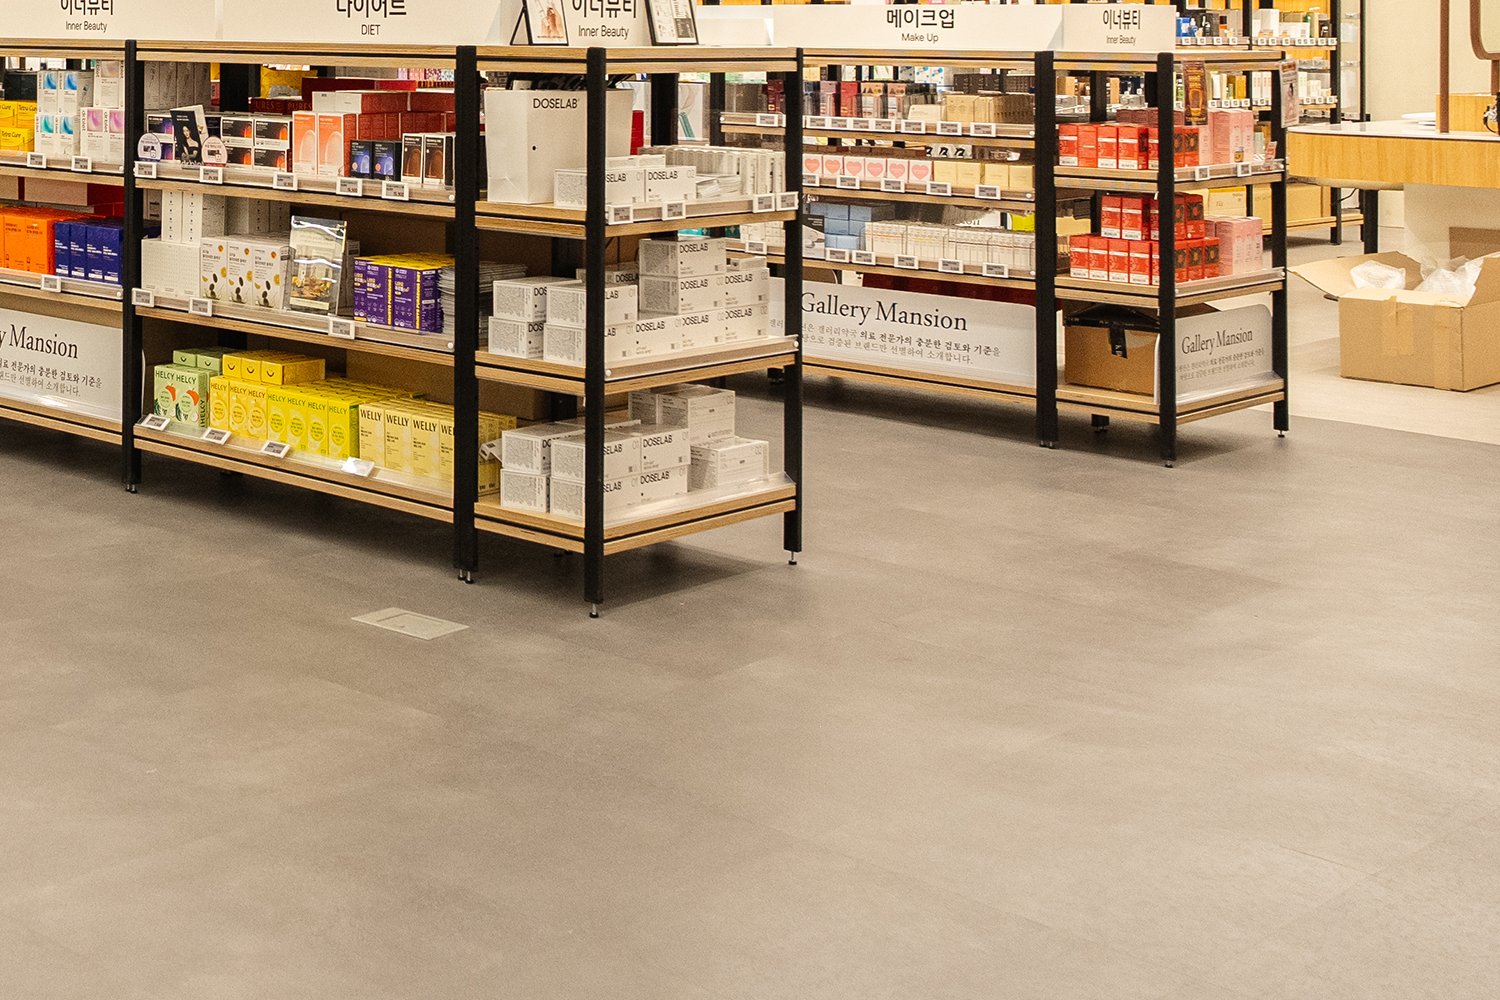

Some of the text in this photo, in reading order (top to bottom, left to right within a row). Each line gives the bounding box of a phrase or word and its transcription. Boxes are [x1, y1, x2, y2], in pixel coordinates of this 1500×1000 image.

[886, 8, 956, 29] 메이크업
[1102, 9, 1141, 30] 이너뷰티
[65, 20, 107, 32] Inner Beauty
[361, 23, 380, 36] DIET
[578, 25, 629, 40] Inner Beauty
[901, 32, 939, 43] Make Up
[1106, 35, 1136, 46] Inner Beauty
[533, 97, 578, 110] DOSELAB
[636, 172, 643, 181] 01
[648, 170, 678, 180] DOSELAB
[687, 169, 695, 179] 02
[679, 243, 708, 254] DOSELAB
[680, 279, 708, 290] DOSELAB
[725, 273, 753, 285] DOSELAB
[800, 292, 968, 332] Gallery Mansion
[636, 320, 665, 333] DOSELAB
[9, 324, 78, 359] Mansion
[860, 330, 876, 340] 의료
[879, 332, 912, 346] 전문가의
[916, 337, 941, 348] 충분한
[944, 340, 970, 353] 검토와
[974, 345, 1002, 357] 기준을
[1182, 327, 1253, 355] Gallery Mansion
[854, 340, 887, 354] 브랜드만
[926, 350, 972, 365] 소개합니다.
[11, 360, 36, 376] 전문가의
[38, 366, 58, 380] 충분한
[60, 370, 80, 384] 검토와
[155, 370, 175, 382] HELCY
[176, 373, 197, 385] HELCY
[46, 380, 80, 397] 소개합니다.
[211, 382, 228, 392] HELCY
[230, 385, 248, 396] HELCY
[248, 388, 266, 399] HELCY
[268, 392, 286, 404] HELCY
[287, 396, 307, 407] HELCY
[307, 400, 326, 411] HELCY
[328, 404, 348, 416] HELCY
[360, 408, 382, 422] WELLY
[386, 414, 410, 428] WELLY
[413, 419, 438, 432] WELLY
[643, 434, 673, 448] DOSELAB
[640, 471, 670, 484] DOSELAB
